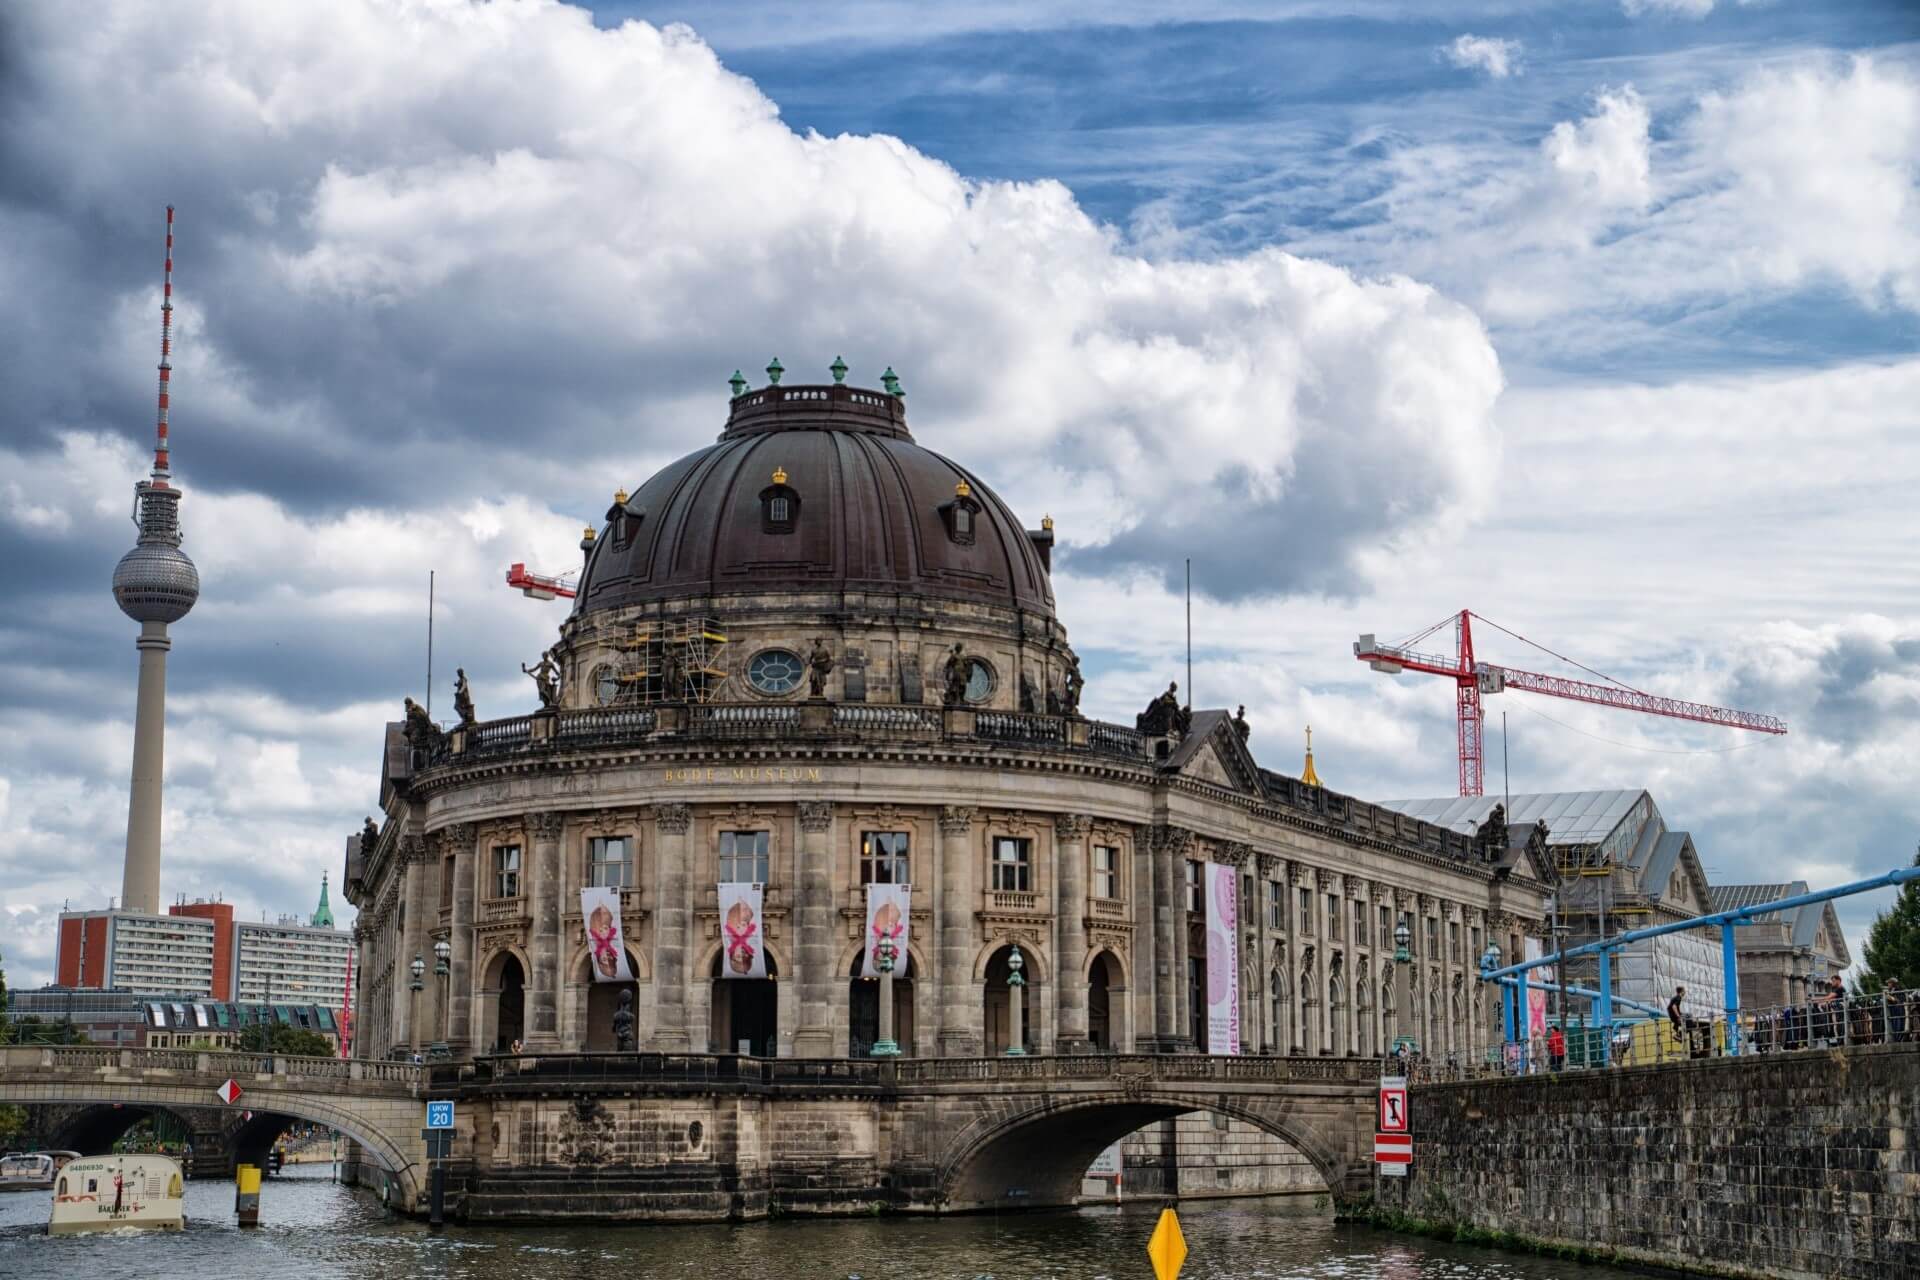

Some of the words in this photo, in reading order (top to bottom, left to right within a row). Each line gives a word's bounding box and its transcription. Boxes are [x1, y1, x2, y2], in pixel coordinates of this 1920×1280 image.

[732, 767, 820, 782] MUSEUM
[432, 1104, 448, 1112] UKW
[432, 1113, 448, 1125] 20
